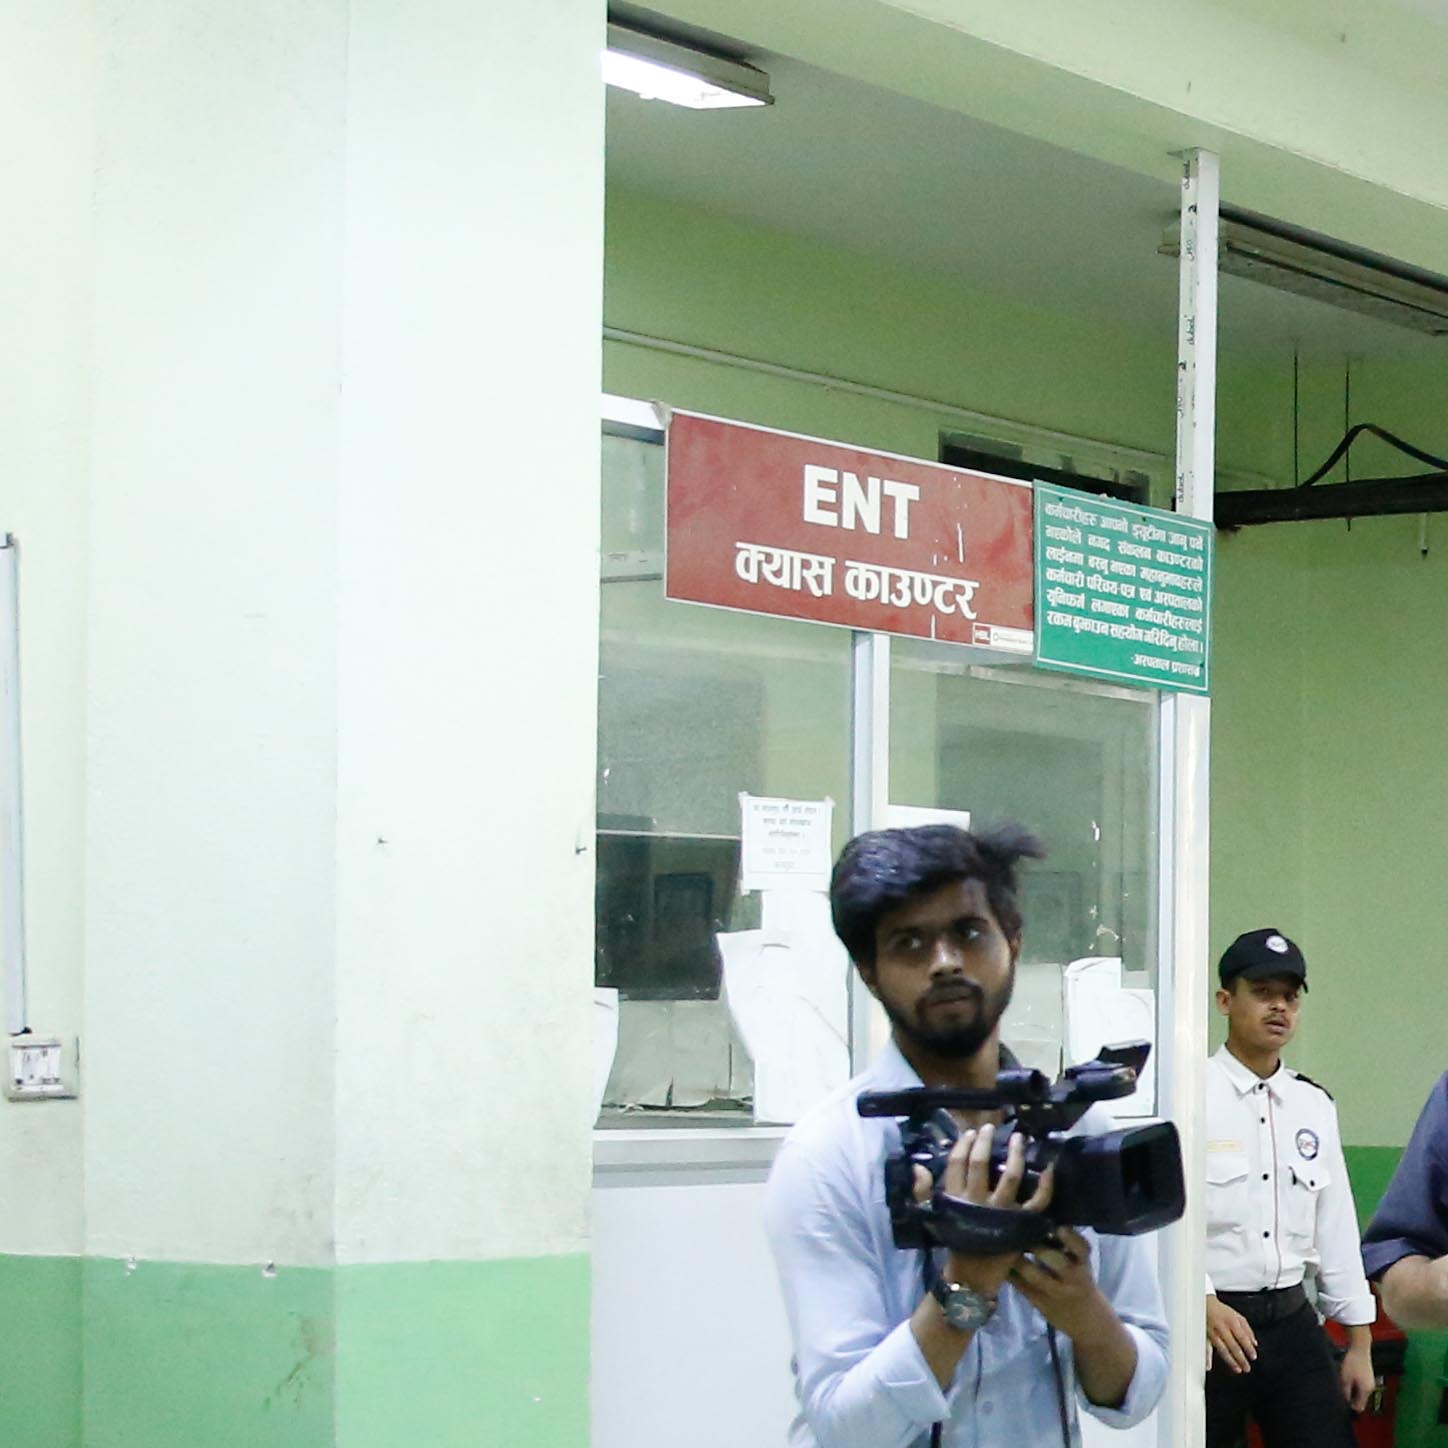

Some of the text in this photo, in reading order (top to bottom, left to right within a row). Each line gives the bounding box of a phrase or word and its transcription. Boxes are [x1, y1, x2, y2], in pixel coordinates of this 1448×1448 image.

[804, 464, 920, 539] ENT
[735, 542, 979, 619] क्यास काउण्टर
